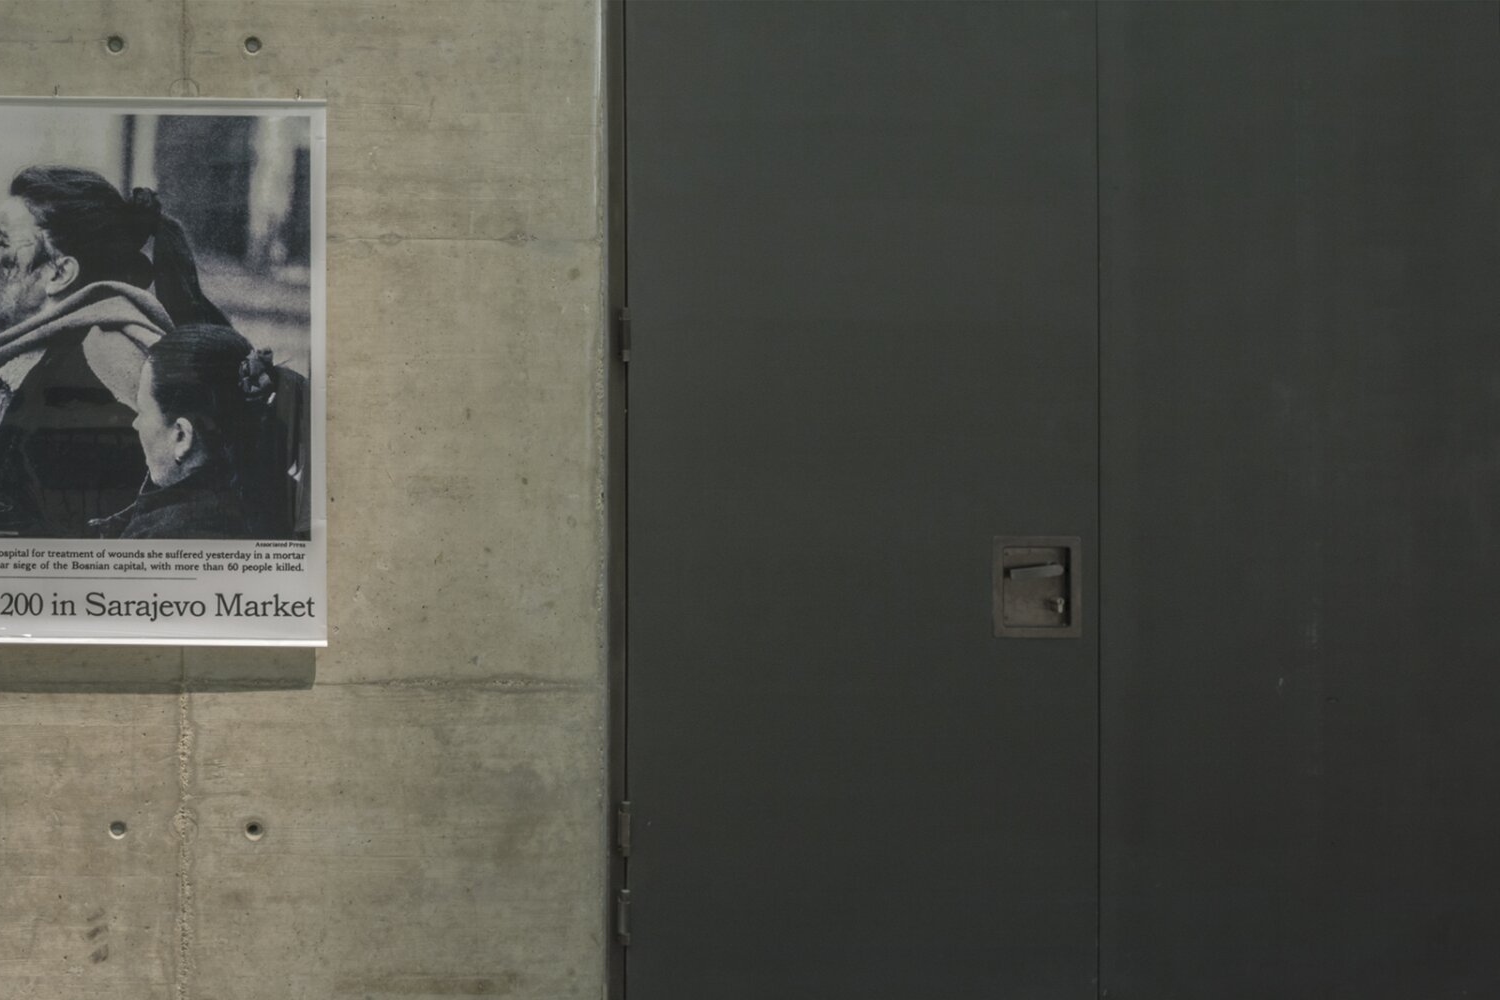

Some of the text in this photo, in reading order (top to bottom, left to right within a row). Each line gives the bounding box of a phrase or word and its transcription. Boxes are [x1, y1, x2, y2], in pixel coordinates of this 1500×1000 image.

[31, 548, 46, 558] for
[47, 550, 94, 558] treatment
[95, 549, 106, 559] of
[107, 549, 146, 559] wounds
[147, 549, 164, 559] she
[165, 549, 204, 559] suffered
[205, 550, 252, 562] yesterday
[253, 550, 263, 560] in
[272, 552, 306, 560] mortar
[13, 560, 37, 572] siege
[39, 560, 51, 570] of
[52, 561, 69, 570] the
[71, 561, 110, 570] Bosnian
[113, 561, 147, 573] capital,
[150, 561, 172, 571] with
[202, 561, 224, 571] than
[227, 562, 239, 571] 60
[241, 562, 273, 574] people
[275, 562, 305, 572] killed.
[0, 592, 44, 617] 200
[51, 592, 77, 616] in
[85, 592, 206, 622] Sarajevo
[214, 593, 316, 618] Market
